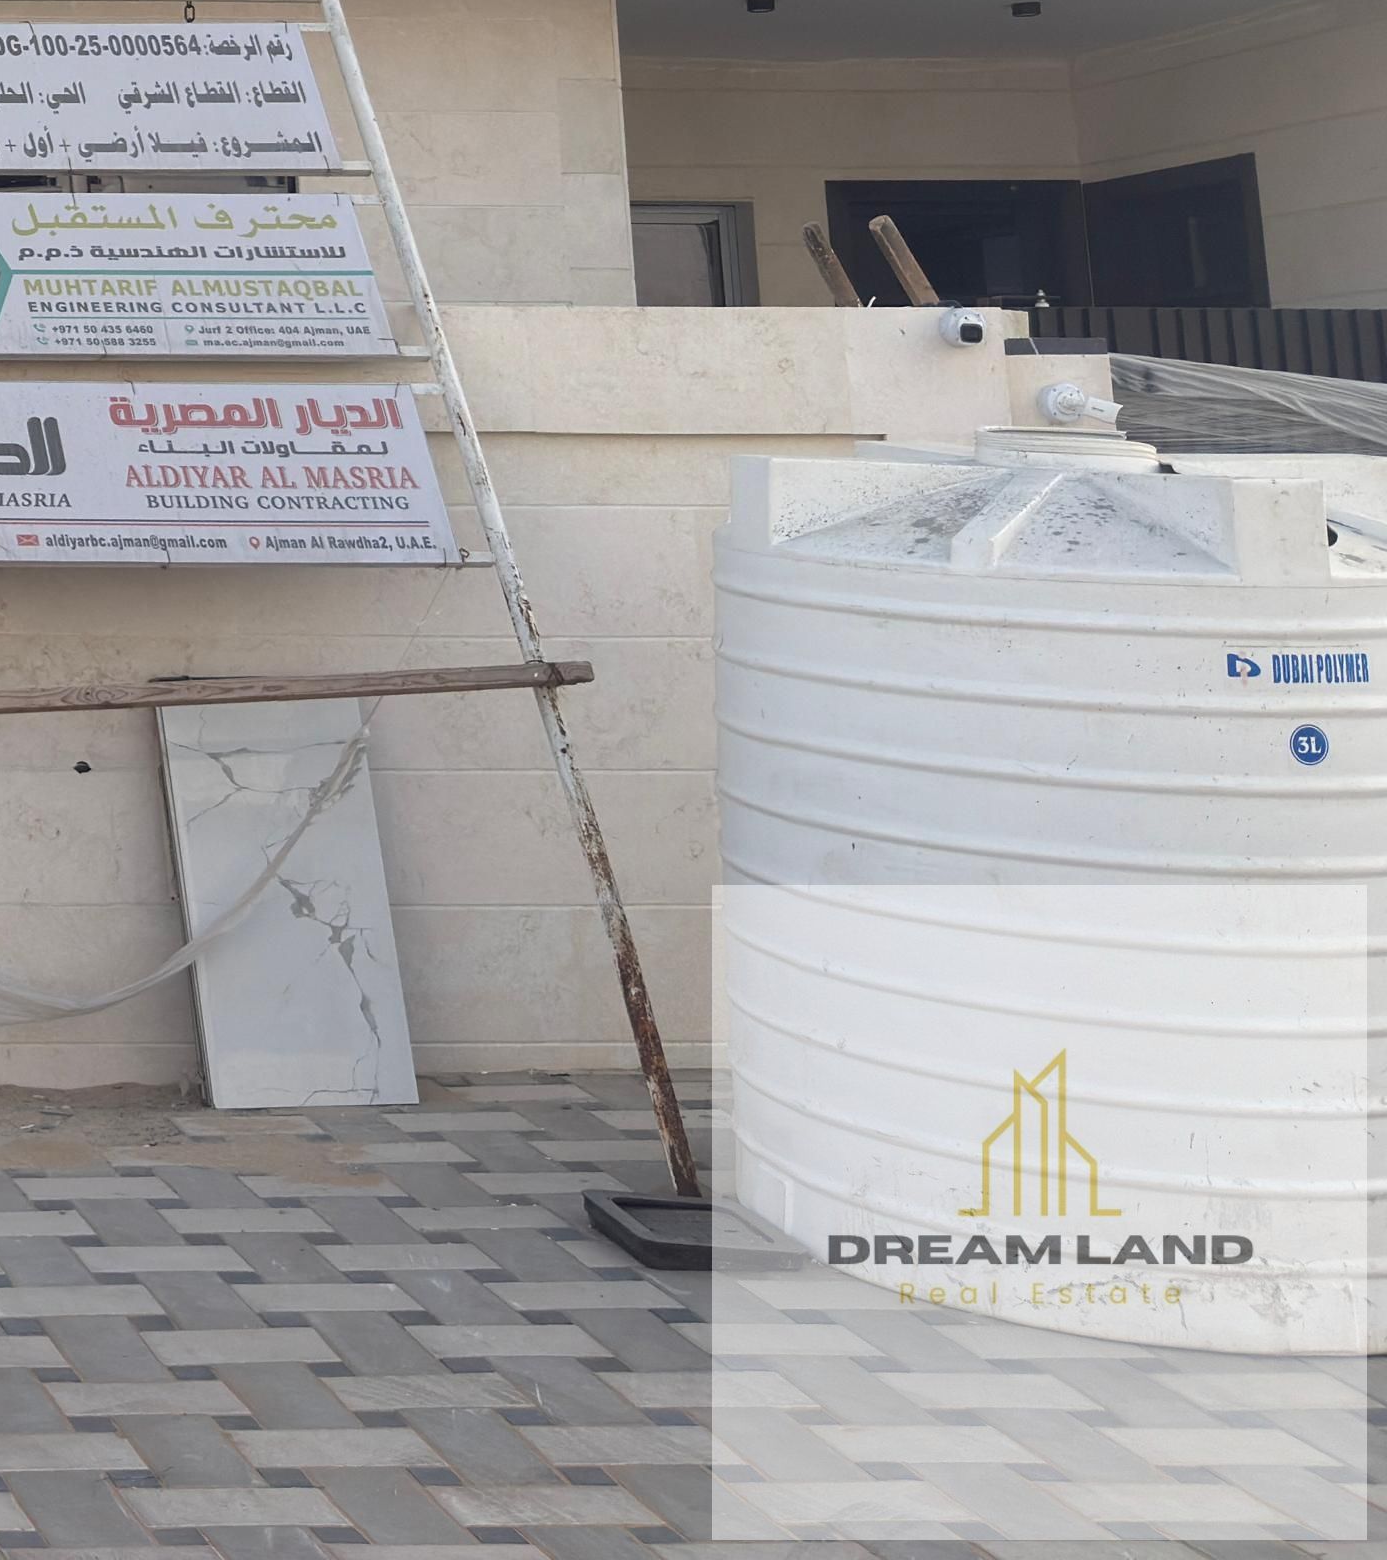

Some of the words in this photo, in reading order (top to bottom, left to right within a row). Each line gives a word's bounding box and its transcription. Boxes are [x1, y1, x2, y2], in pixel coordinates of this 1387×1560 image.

[267, 34, 293, 63] رقم
[38, 81, 86, 115] الحي:
[118, 80, 180, 115] الشرقي
[186, 80, 242, 108] القطاع
[245, 80, 308, 108] القطاع:
[23, 125, 54, 159] أول
[78, 125, 145, 163] أرضي
[147, 130, 208, 158] فيلا
[12, 202, 178, 237] المستقبل
[194, 203, 338, 239] محترف
[17, 244, 84, 261] ذ.م.م
[89, 244, 208, 261] الهندسية
[213, 244, 347, 261] للاستشارات
[23, 278, 158, 297] MUHTARIF
[170, 279, 364, 302] ALMUSTAQBAL
[27, 301, 163, 313] ENGINEERING
[171, 302, 307, 314] CONSULTANT
[314, 303, 367, 315] L.L.C
[52, 325, 79, 334] +971
[83, 325, 97, 334] 50
[101, 325, 122, 334] 435
[55, 337, 82, 346] +971
[86, 337, 100, 346] 50
[128, 337, 157, 346] 3255
[198, 325, 221, 335] Jurf
[225, 325, 233, 334] 2
[236, 325, 275, 335] Office:
[278, 326, 300, 335] 404
[303, 326, 343, 337] Ajman,
[346, 326, 372, 336] UAE
[109, 396, 283, 435] المصرية
[295, 397, 404, 436] الديار
[138, 440, 235, 457] البناء
[125, 464, 253, 489] ALDIYAR
[261, 465, 296, 490] AL
[304, 466, 420, 491] MASRIA
[146, 494, 249, 510] BUILDING
[257, 495, 410, 511] CONTRACTING
[45, 533, 228, 552] aldiyarbc.ajman@gmail.com
[265, 535, 307, 552] Ajman
[310, 536, 325, 550] Al
[327, 536, 393, 552] Rawdha2,
[396, 536, 438, 551] U.A.E.
[1272, 653, 1314, 684] DUBAI
[1316, 652, 1370, 684] POLYMER
[1297, 736, 1322, 754] 3L
